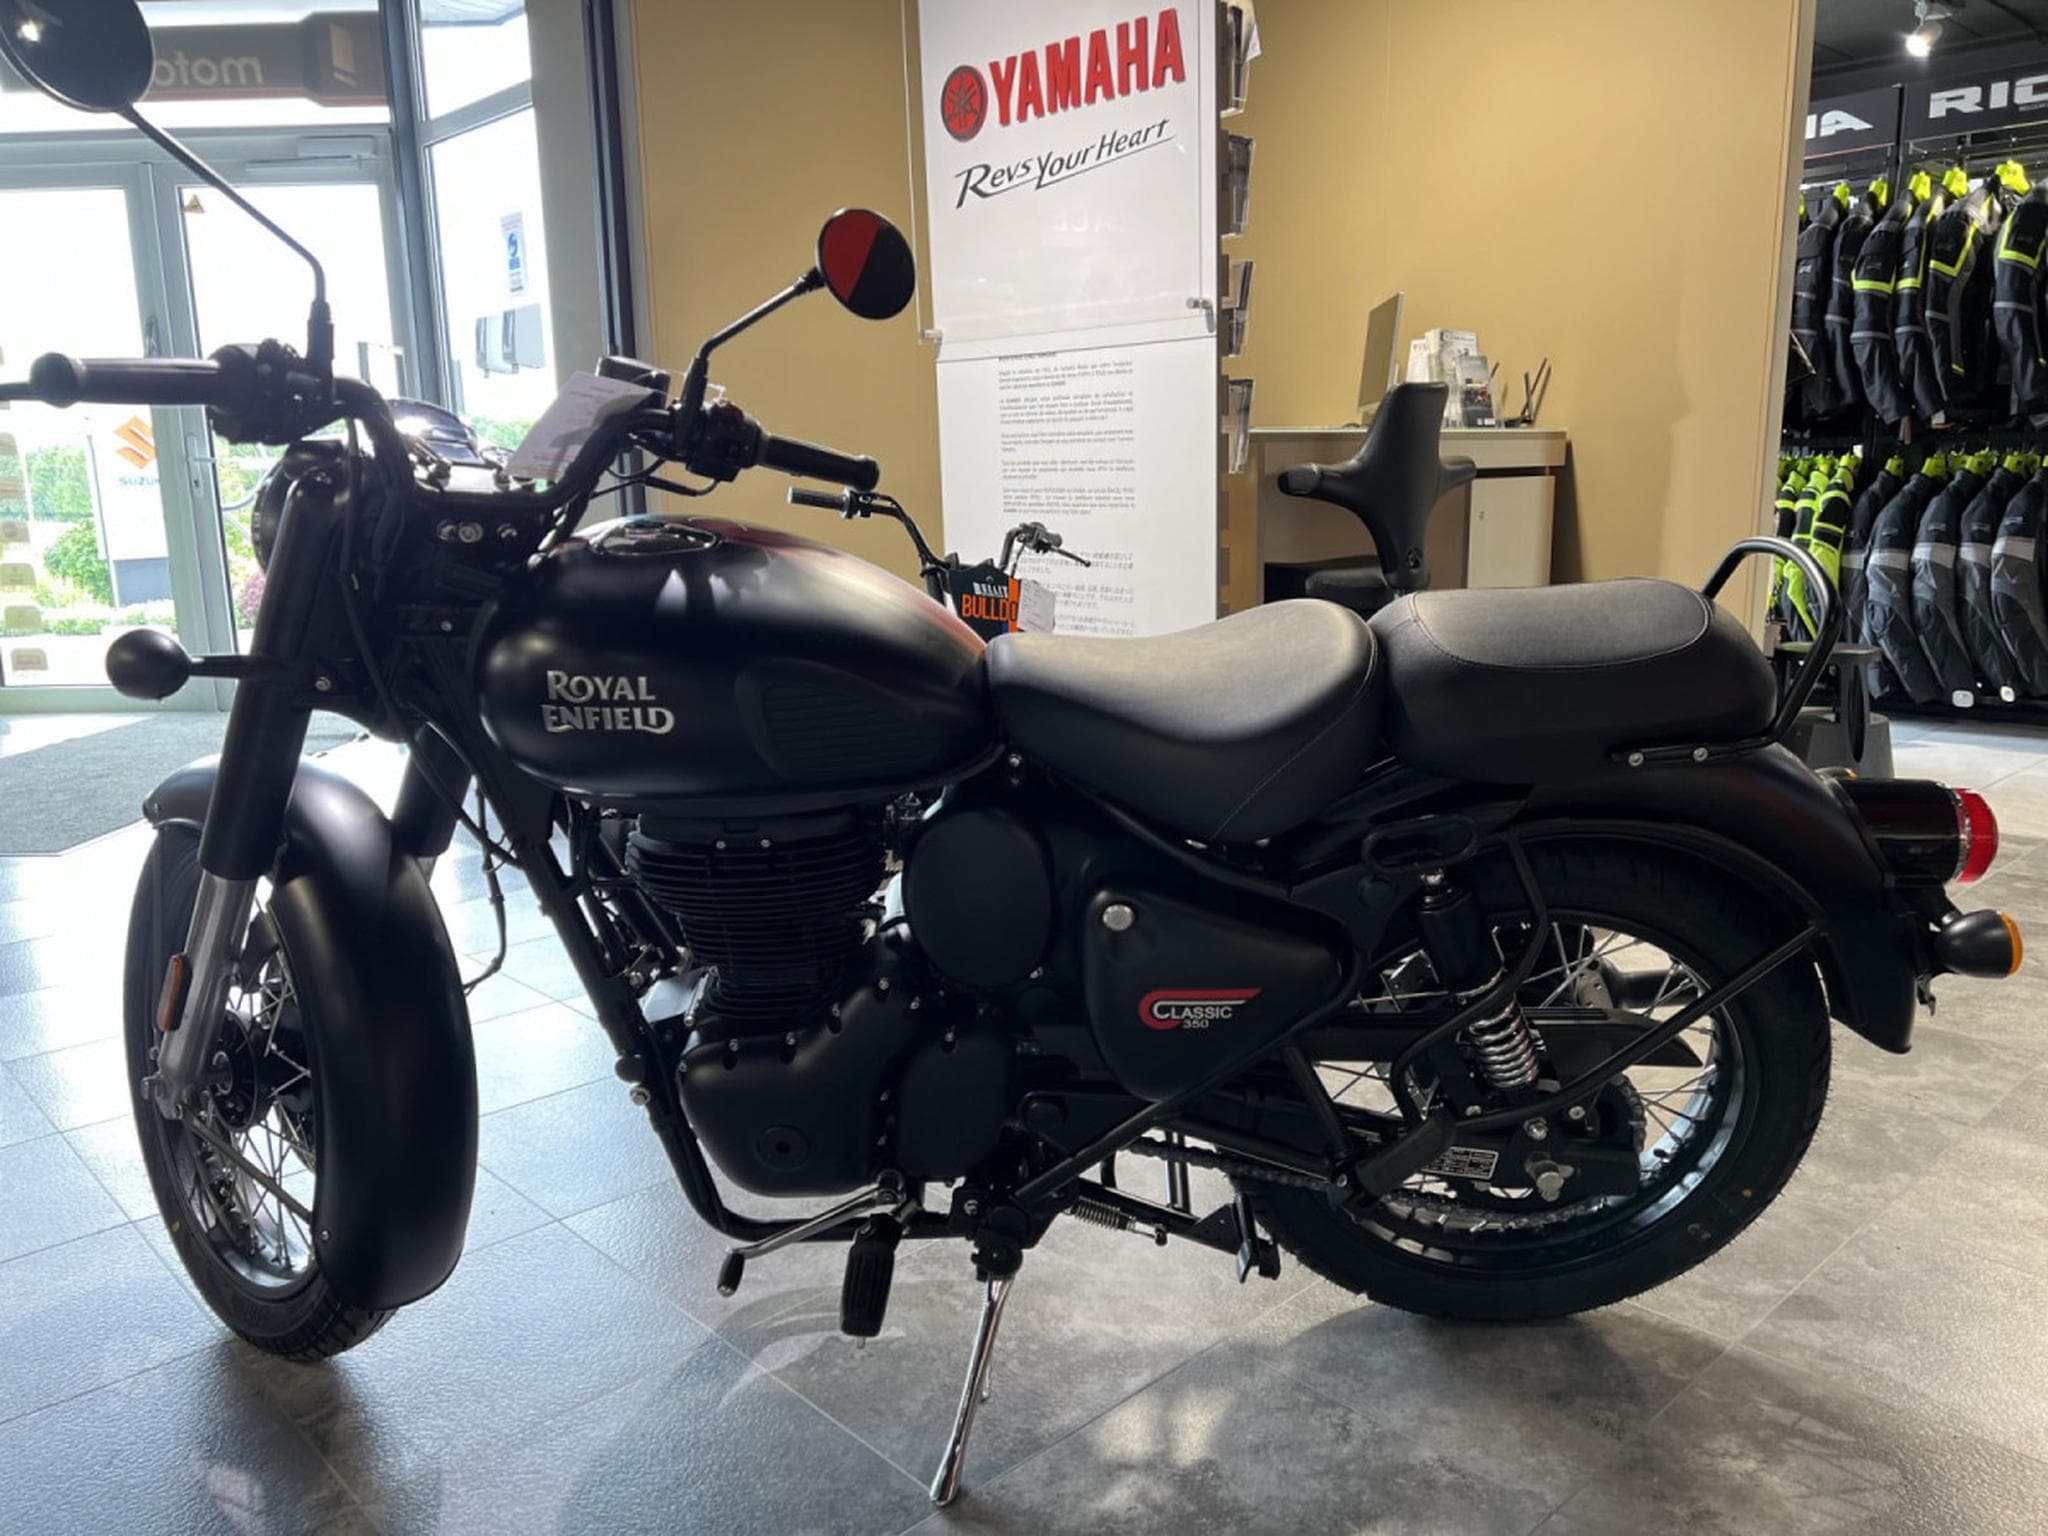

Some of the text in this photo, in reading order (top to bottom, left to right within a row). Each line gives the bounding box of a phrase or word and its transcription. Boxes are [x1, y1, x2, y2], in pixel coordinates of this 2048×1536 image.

[989, 8, 1186, 127] YAMAHA
[954, 118, 1171, 210] Revs Your Heart
[546, 670, 657, 703] ROYAL
[541, 704, 675, 734] ENFIELD
[1152, 1000, 1242, 1020] CLASSIC
[1182, 1018, 1210, 1029] 350
